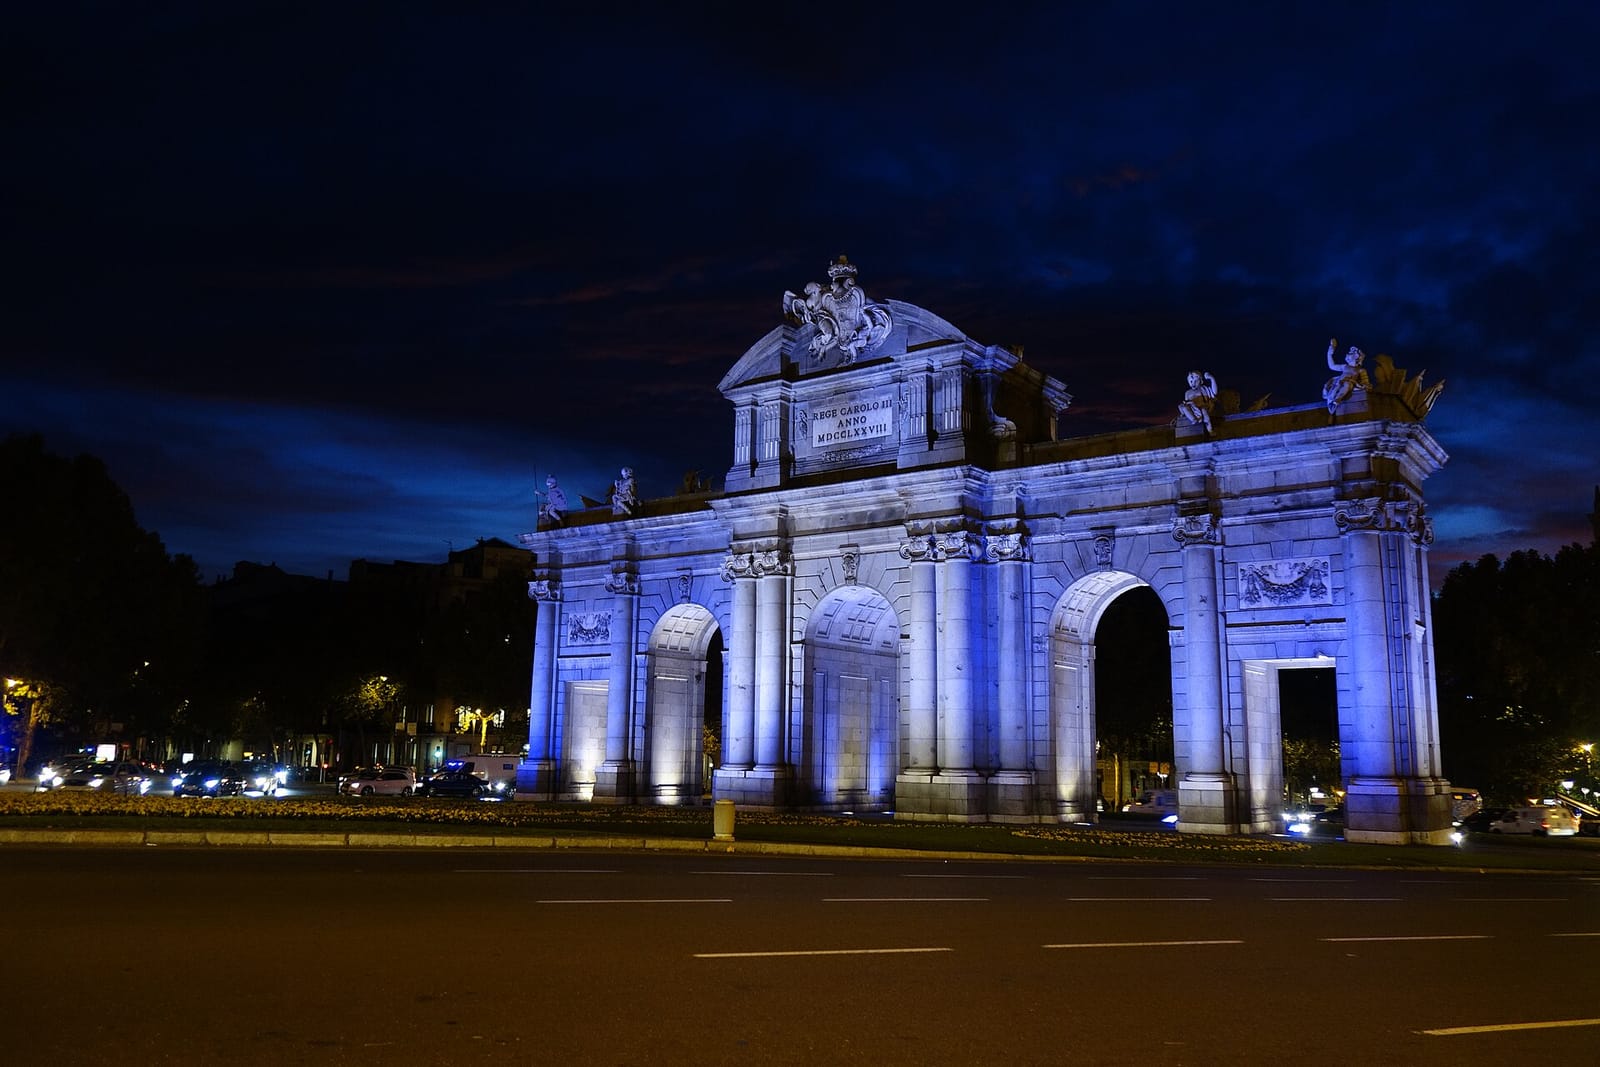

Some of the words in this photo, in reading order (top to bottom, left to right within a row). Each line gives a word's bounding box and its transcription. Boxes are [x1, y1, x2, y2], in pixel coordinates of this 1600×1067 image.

[813, 409, 838, 421] REGE
[840, 401, 879, 416] CAROLO
[882, 399, 892, 409] III
[838, 415, 867, 428] ANNO
[818, 423, 887, 443] MDCCLXXVIII
